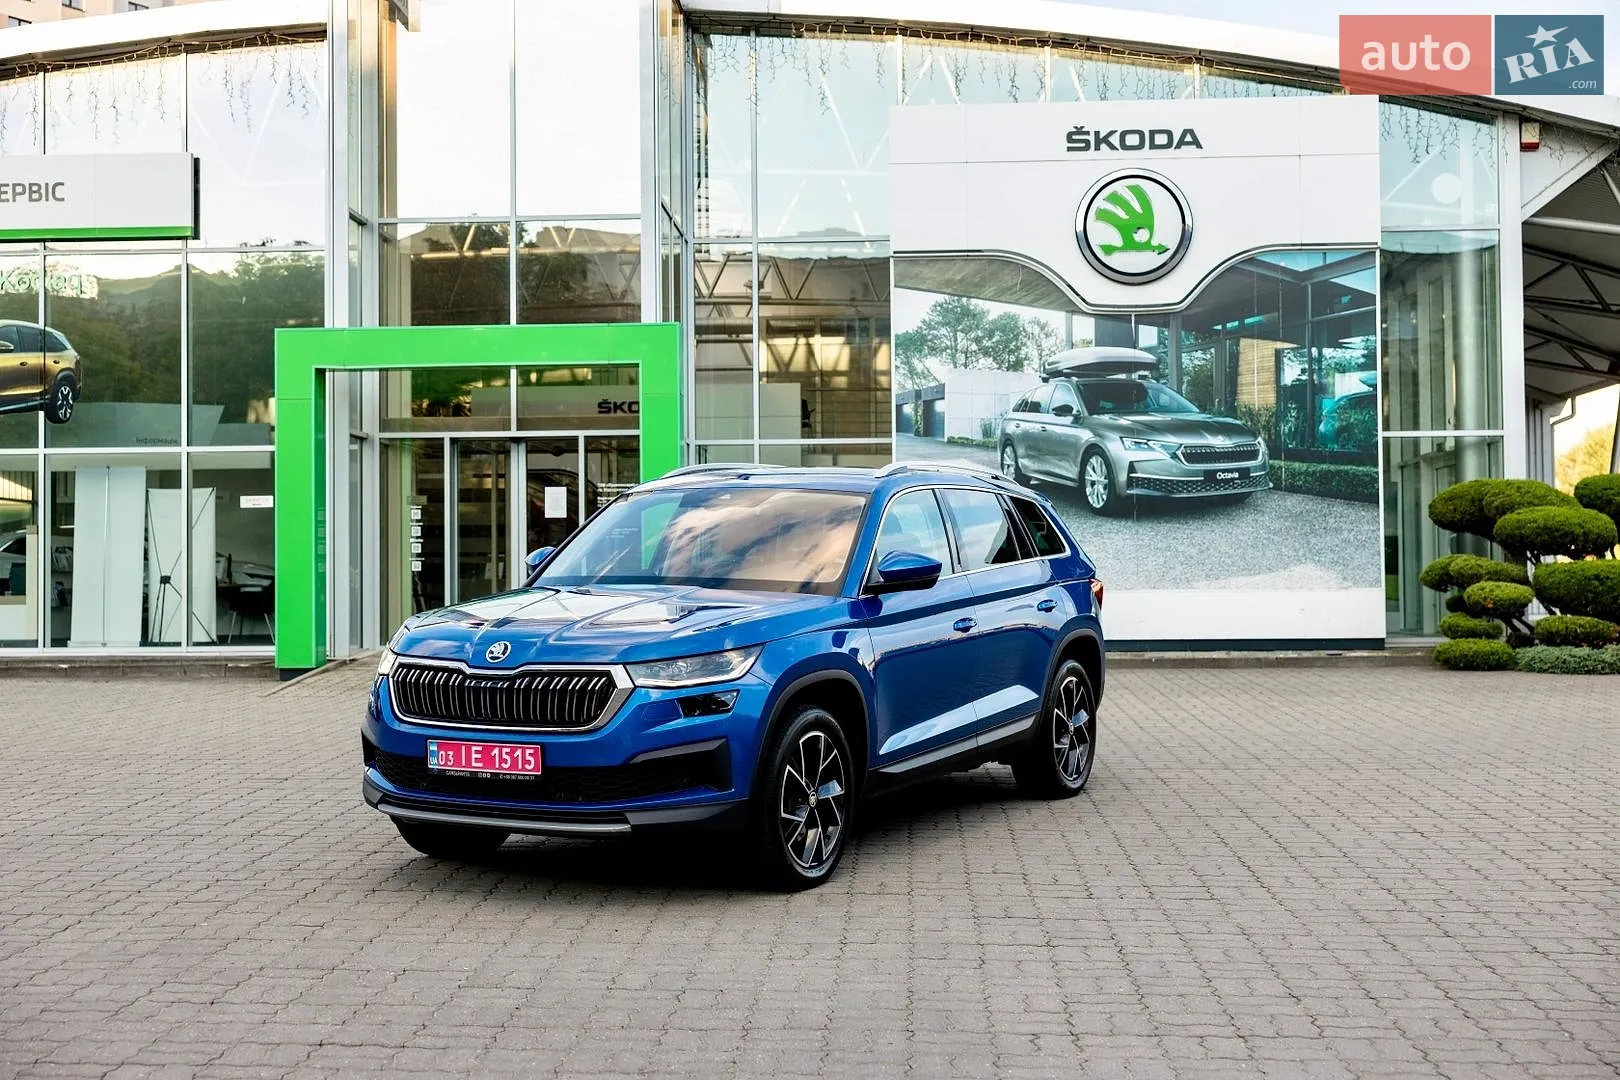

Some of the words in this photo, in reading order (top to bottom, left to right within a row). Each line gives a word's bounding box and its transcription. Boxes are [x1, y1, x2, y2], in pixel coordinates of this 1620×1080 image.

[1066, 126, 1203, 152] ŠKODA
[1216, 471, 1239, 480] Octavia
[438, 750, 455, 766] 03
[490, 746, 536, 770] 1515
